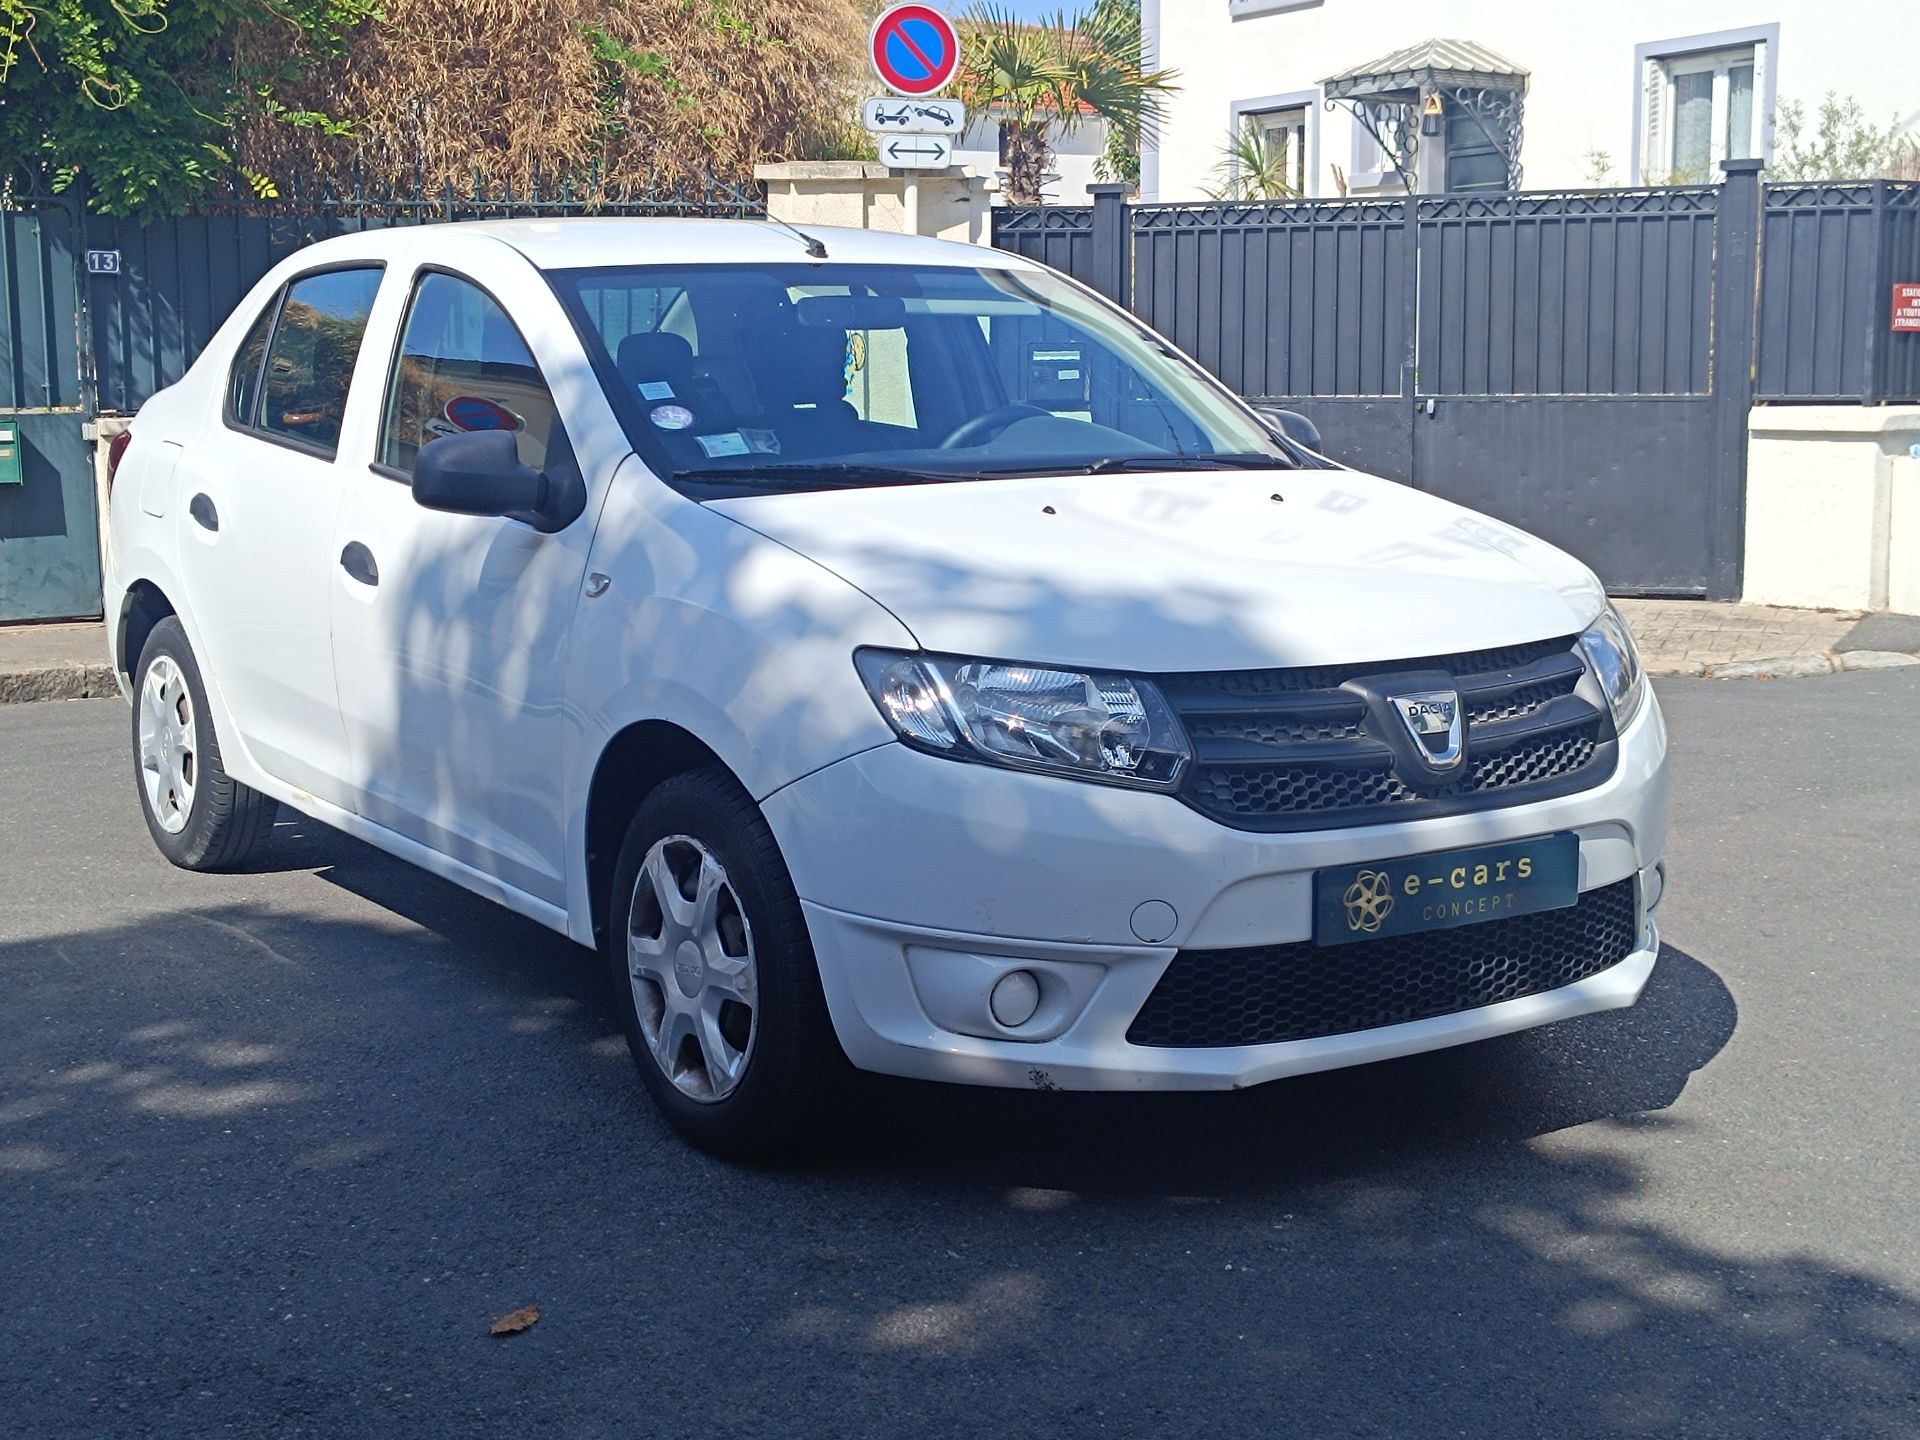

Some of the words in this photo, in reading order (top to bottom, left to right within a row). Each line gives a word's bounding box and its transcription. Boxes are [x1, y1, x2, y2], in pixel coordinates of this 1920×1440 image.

[92, 253, 114, 270] 13
[1896, 307, 1902, 317] A
[1408, 702, 1451, 717] DACIA
[1404, 857, 1532, 895] e-cars
[1423, 893, 1514, 921] CONCEPT
